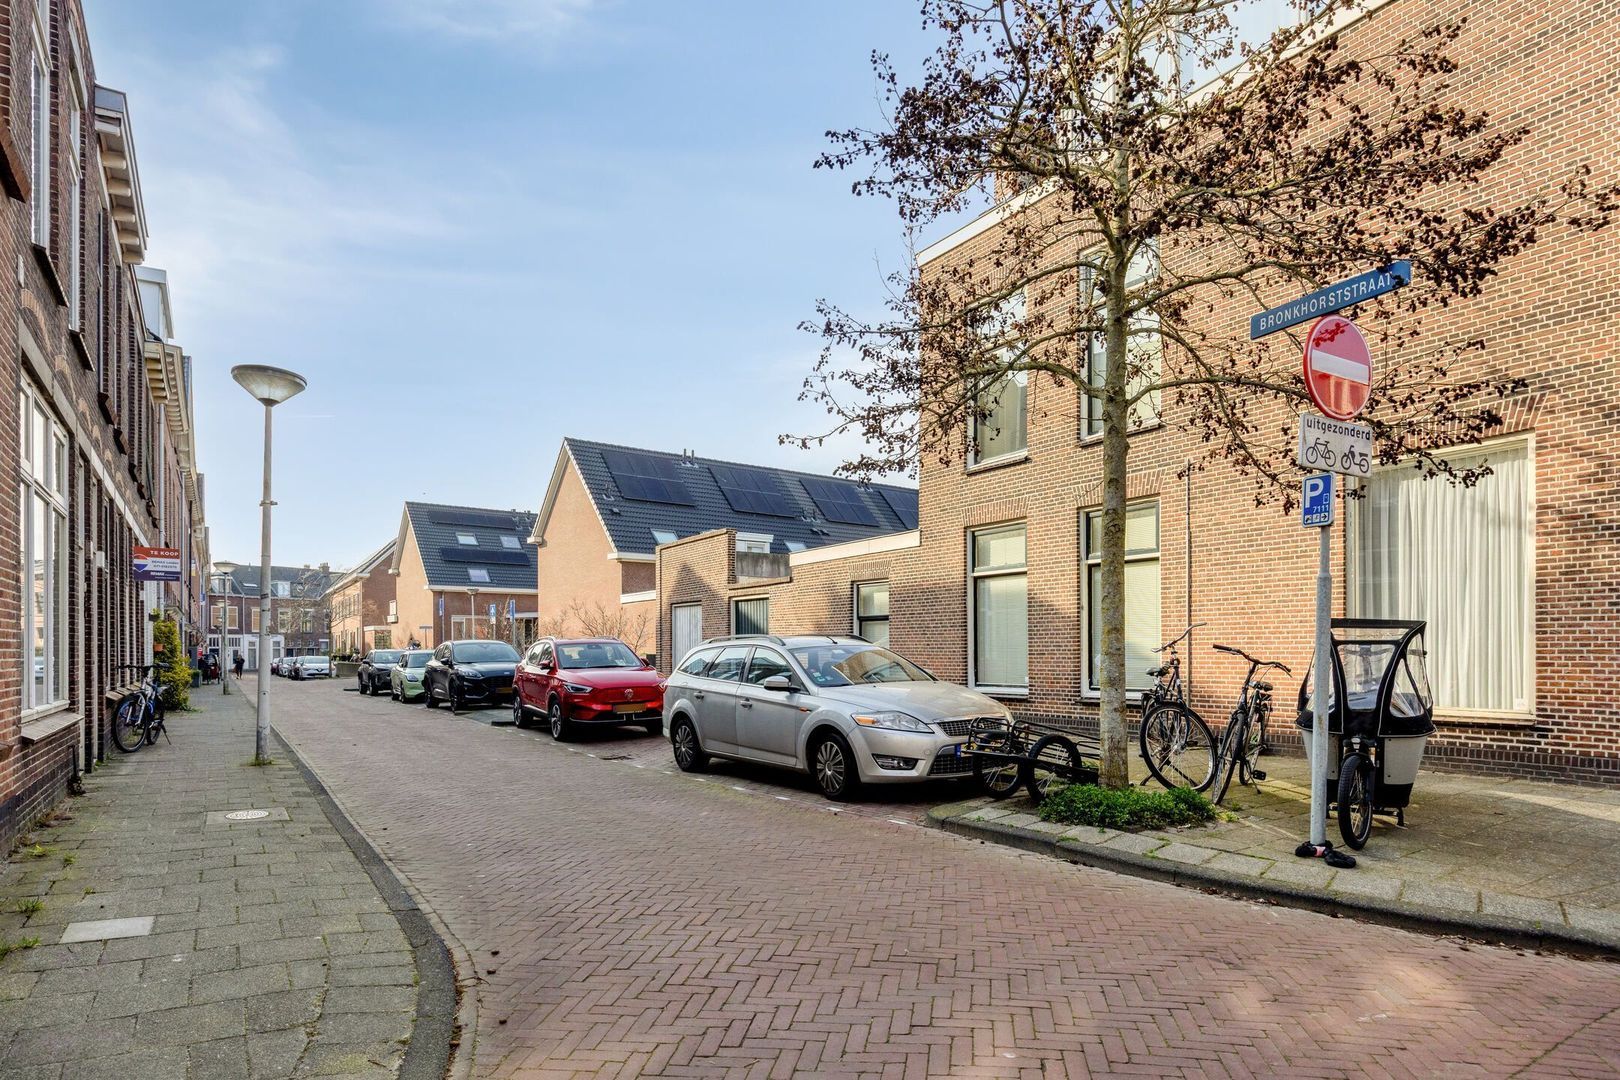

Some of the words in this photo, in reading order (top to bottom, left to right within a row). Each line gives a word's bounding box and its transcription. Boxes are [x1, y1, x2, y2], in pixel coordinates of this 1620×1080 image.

[1259, 272, 1393, 331] BRONKHORSTSTRAAT
[1306, 418, 1371, 440] uitgezonderd
[1305, 478, 1324, 508] P
[1312, 504, 1329, 513] 7111
